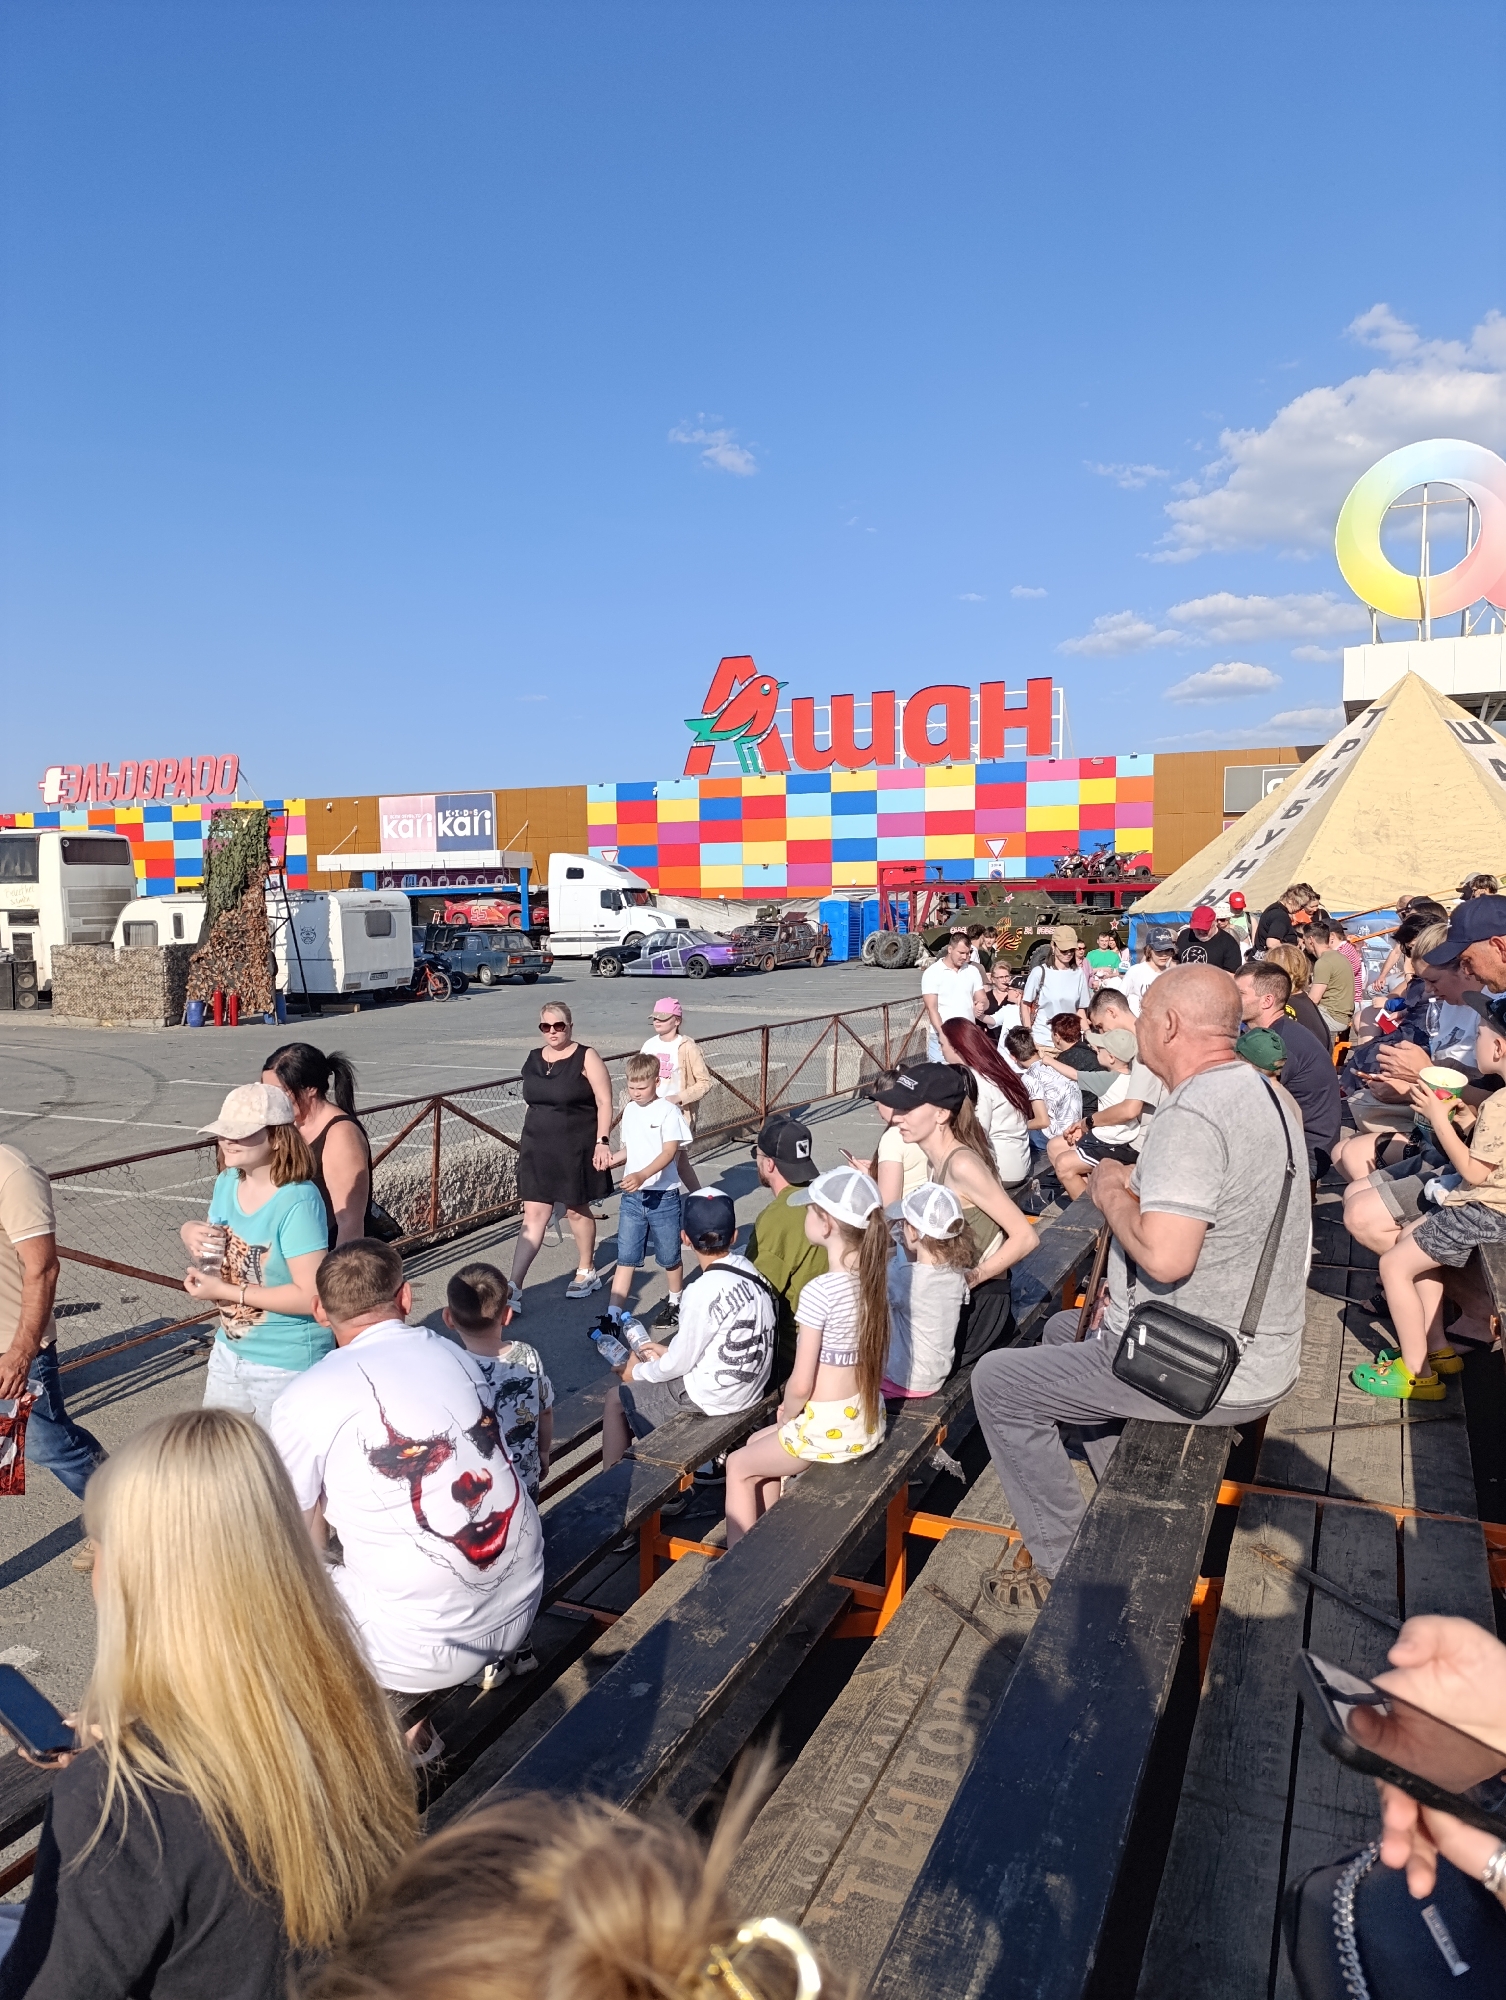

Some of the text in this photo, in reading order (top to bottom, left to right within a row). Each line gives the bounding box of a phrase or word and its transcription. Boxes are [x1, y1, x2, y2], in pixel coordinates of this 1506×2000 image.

[1192, 706, 1388, 907] ТРИБУНЫ
[383, 813, 433, 839] kari
[438, 810, 492, 837] kari
[470, 906, 488, 922] 95
